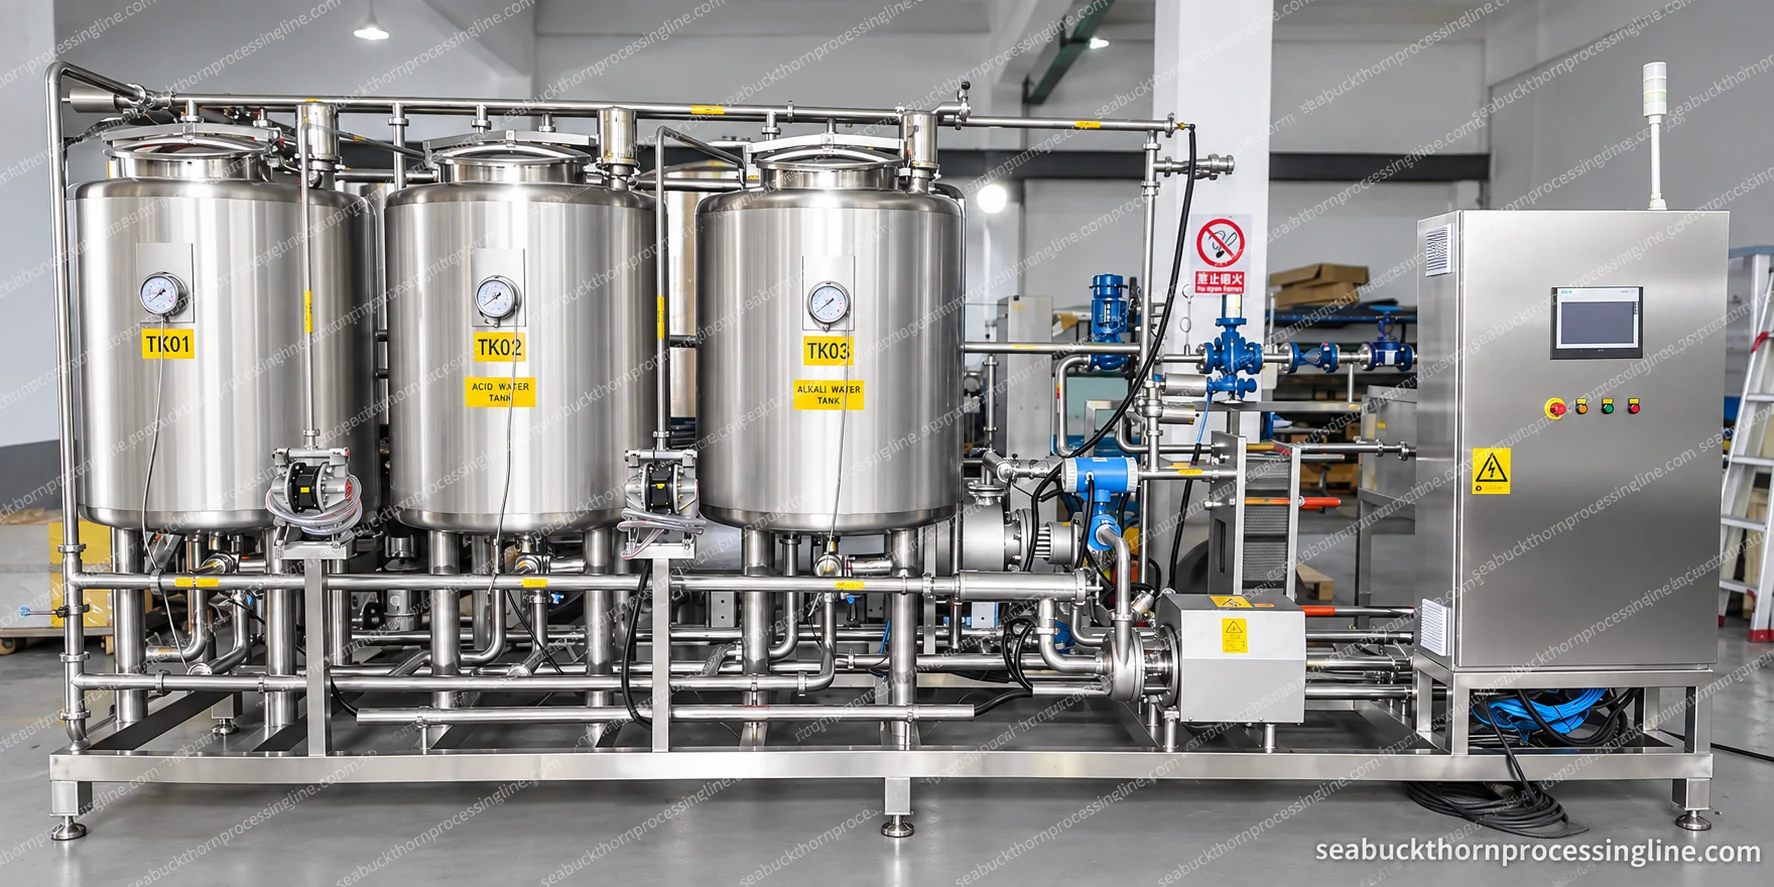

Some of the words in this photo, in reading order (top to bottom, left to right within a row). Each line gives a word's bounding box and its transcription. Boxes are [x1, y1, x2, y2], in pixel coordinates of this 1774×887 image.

[146, 336, 188, 352] TK01
[478, 339, 521, 356] TK02
[807, 342, 850, 359] TK03
